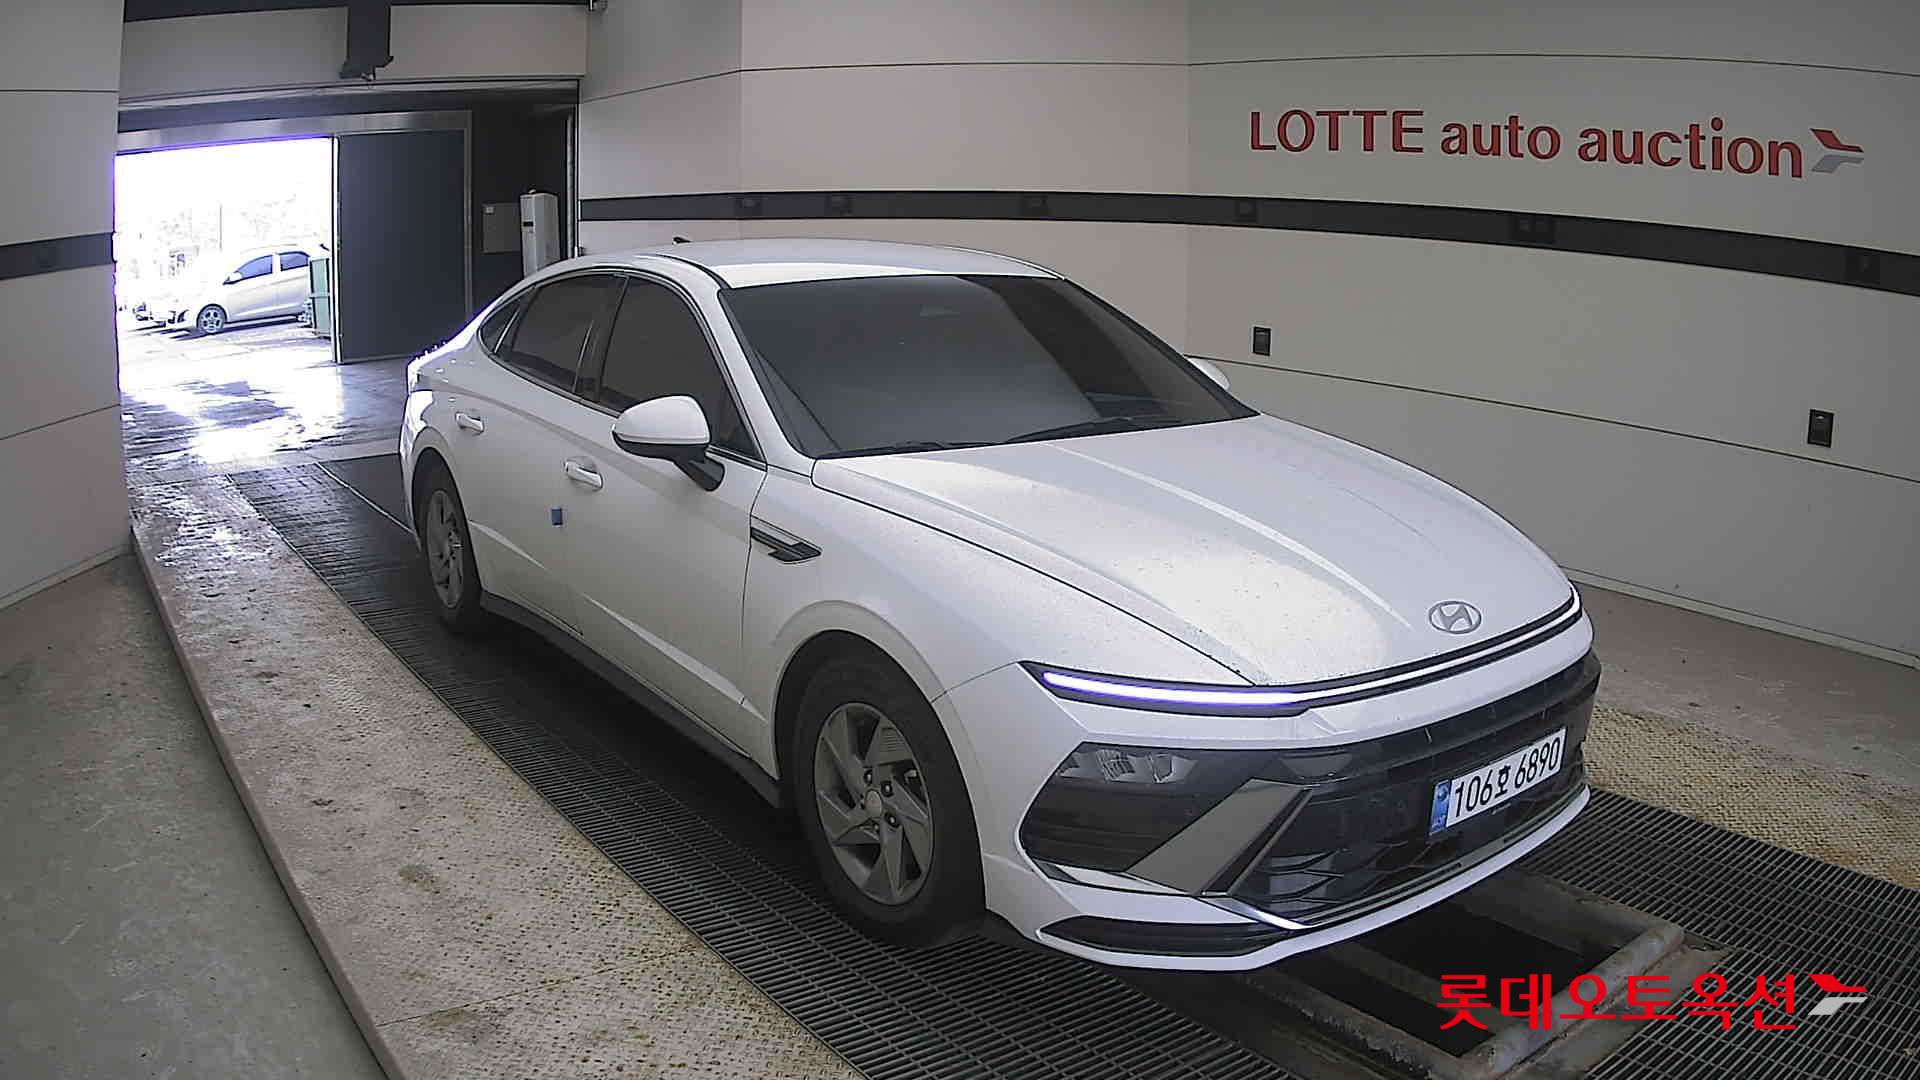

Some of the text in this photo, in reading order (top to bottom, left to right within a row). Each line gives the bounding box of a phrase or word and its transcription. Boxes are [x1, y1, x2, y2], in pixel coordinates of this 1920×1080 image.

[1250, 109, 1803, 179] LOTTE auto auction
[1455, 737, 1561, 818] 106호 6890
